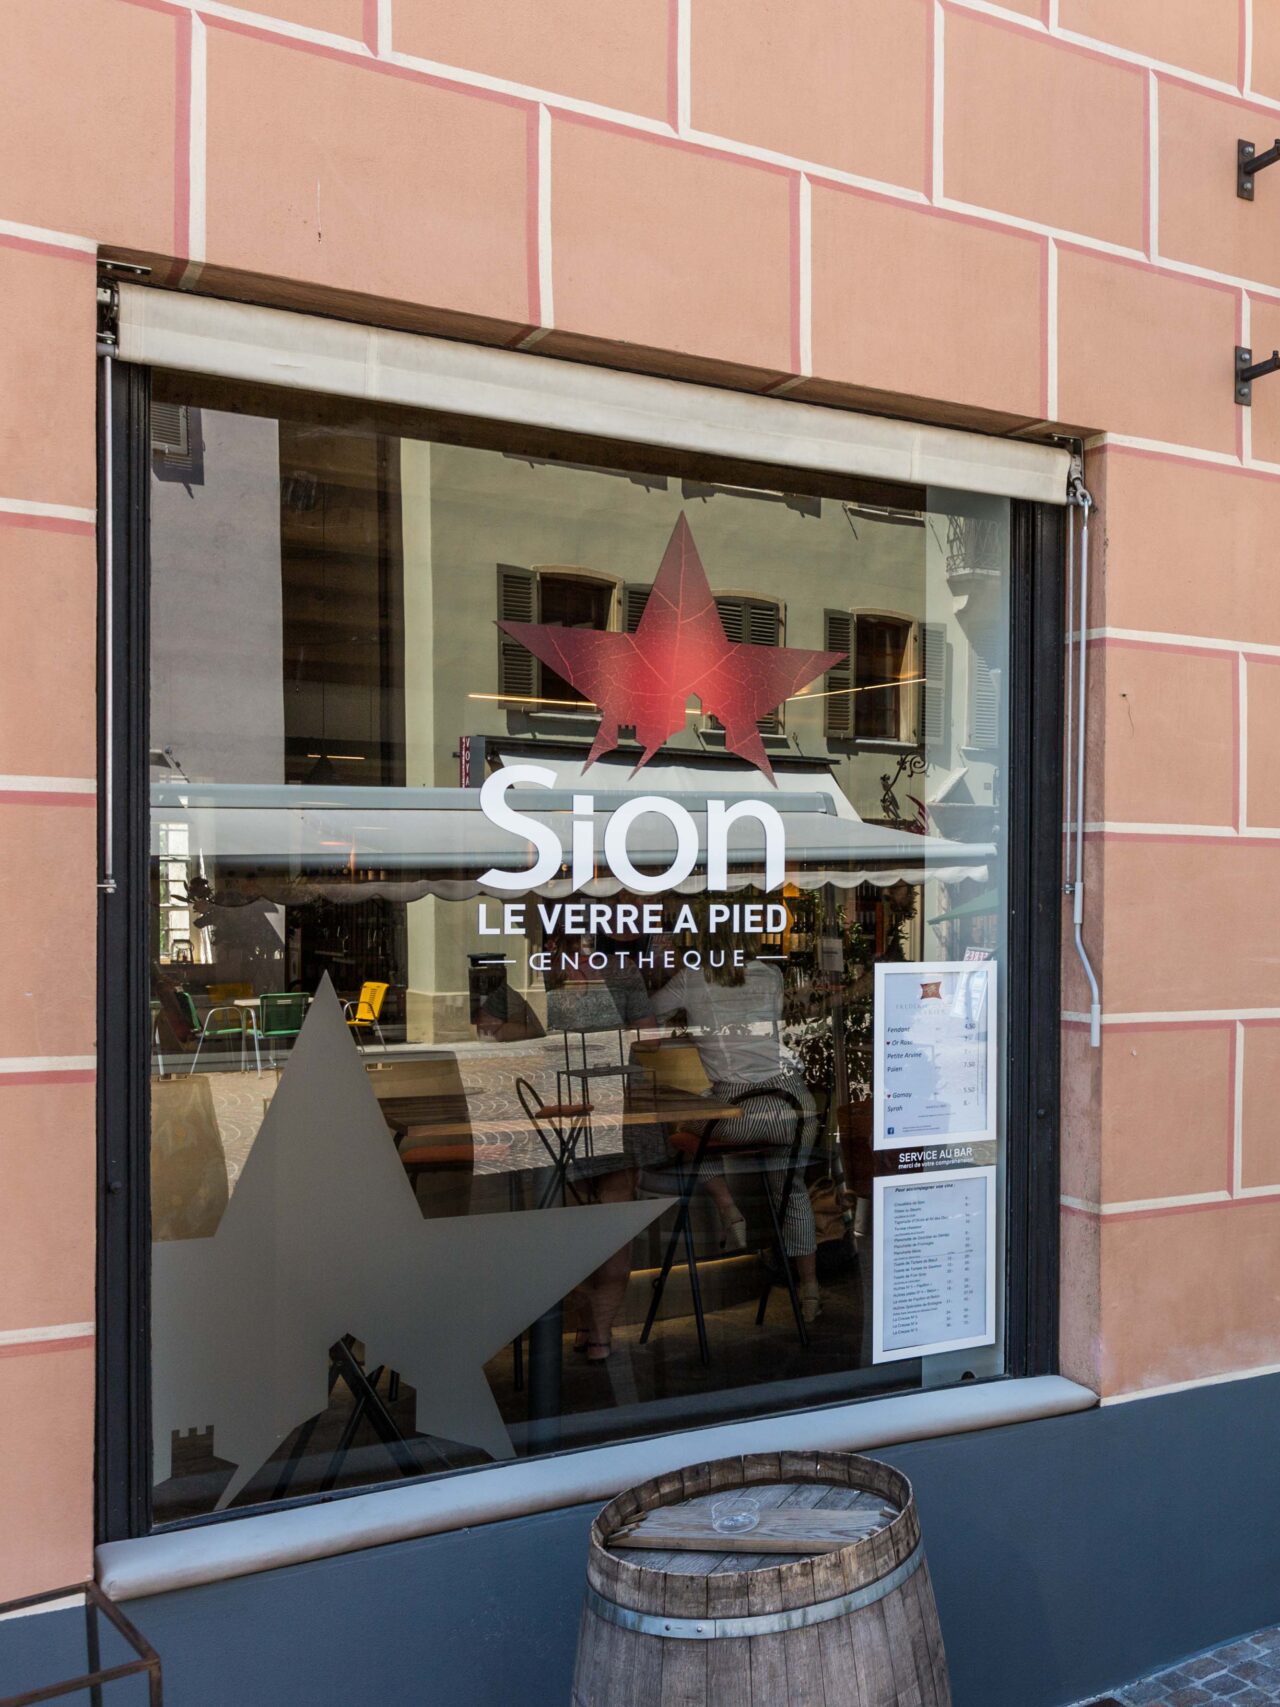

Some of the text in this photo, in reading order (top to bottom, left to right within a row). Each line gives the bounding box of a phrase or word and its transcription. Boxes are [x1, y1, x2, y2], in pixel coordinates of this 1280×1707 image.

[476, 764, 785, 893] Sion
[478, 903, 788, 935] LE VERRE A PIED
[899, 1147, 973, 1163] SERVICE AU BAR
